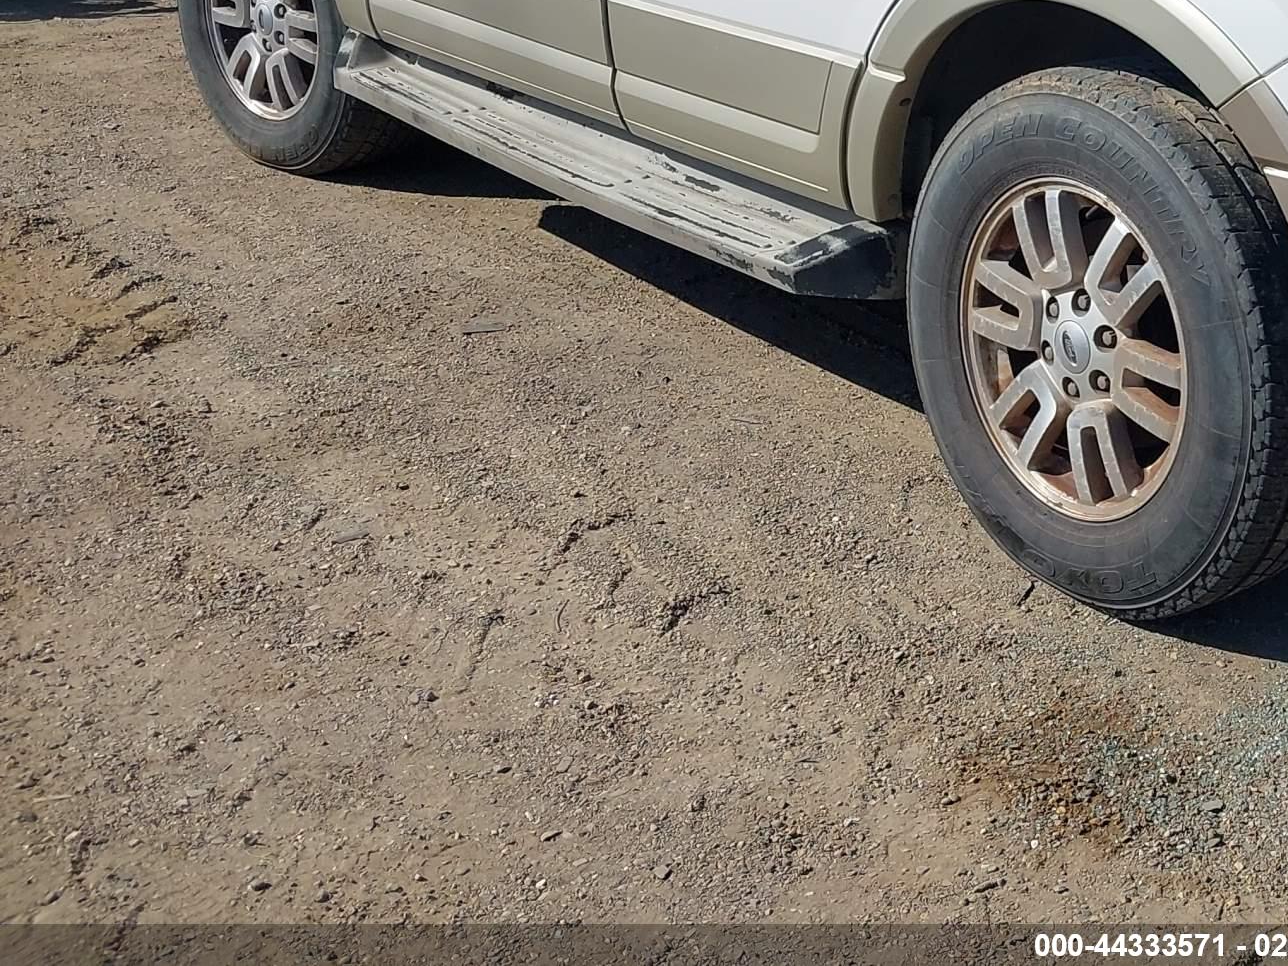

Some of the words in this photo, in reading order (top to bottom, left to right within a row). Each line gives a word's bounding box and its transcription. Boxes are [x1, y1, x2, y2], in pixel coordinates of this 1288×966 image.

[959, 113, 1044, 175] OPEN
[1055, 117, 1210, 285] COUNTRY
[1022, 547, 1158, 595] TOYO
